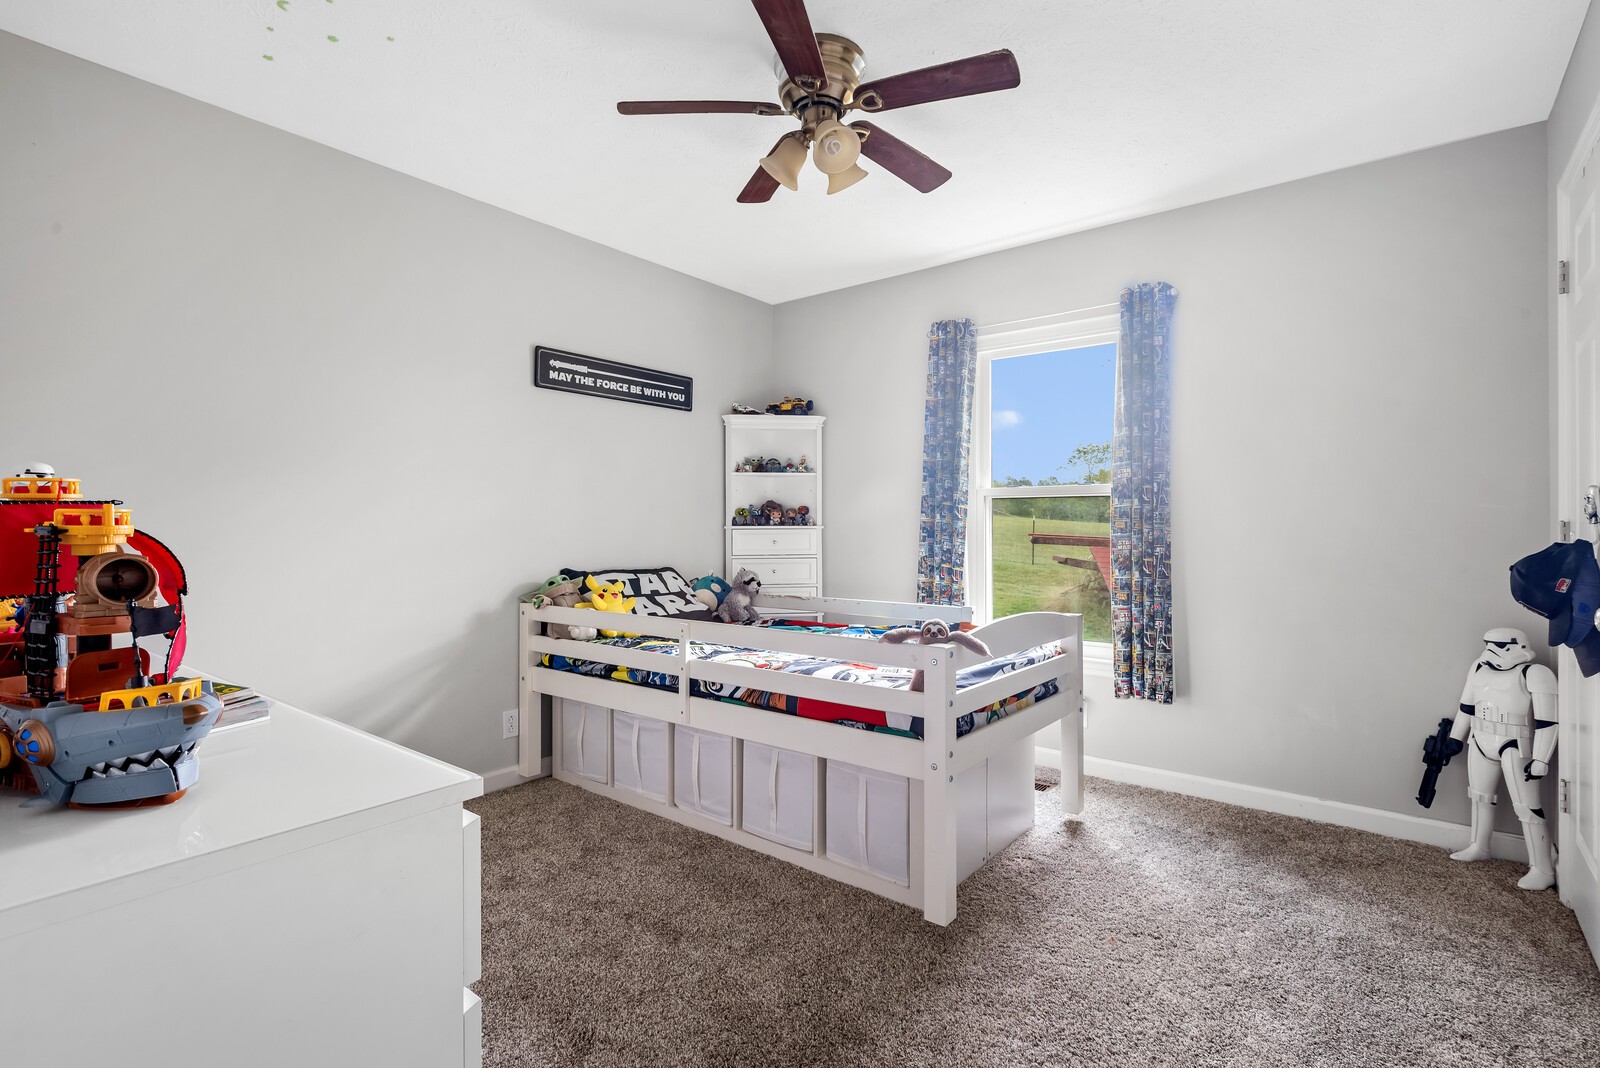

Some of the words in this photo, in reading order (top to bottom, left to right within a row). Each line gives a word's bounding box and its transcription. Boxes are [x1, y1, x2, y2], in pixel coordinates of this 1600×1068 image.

[549, 370, 573, 382] MAY
[574, 375, 595, 386] THE
[596, 379, 628, 392] FORCE
[630, 385, 642, 395] BE
[643, 387, 666, 398] WITH
[667, 392, 685, 402] YOU
[622, 593, 709, 616] ARS
